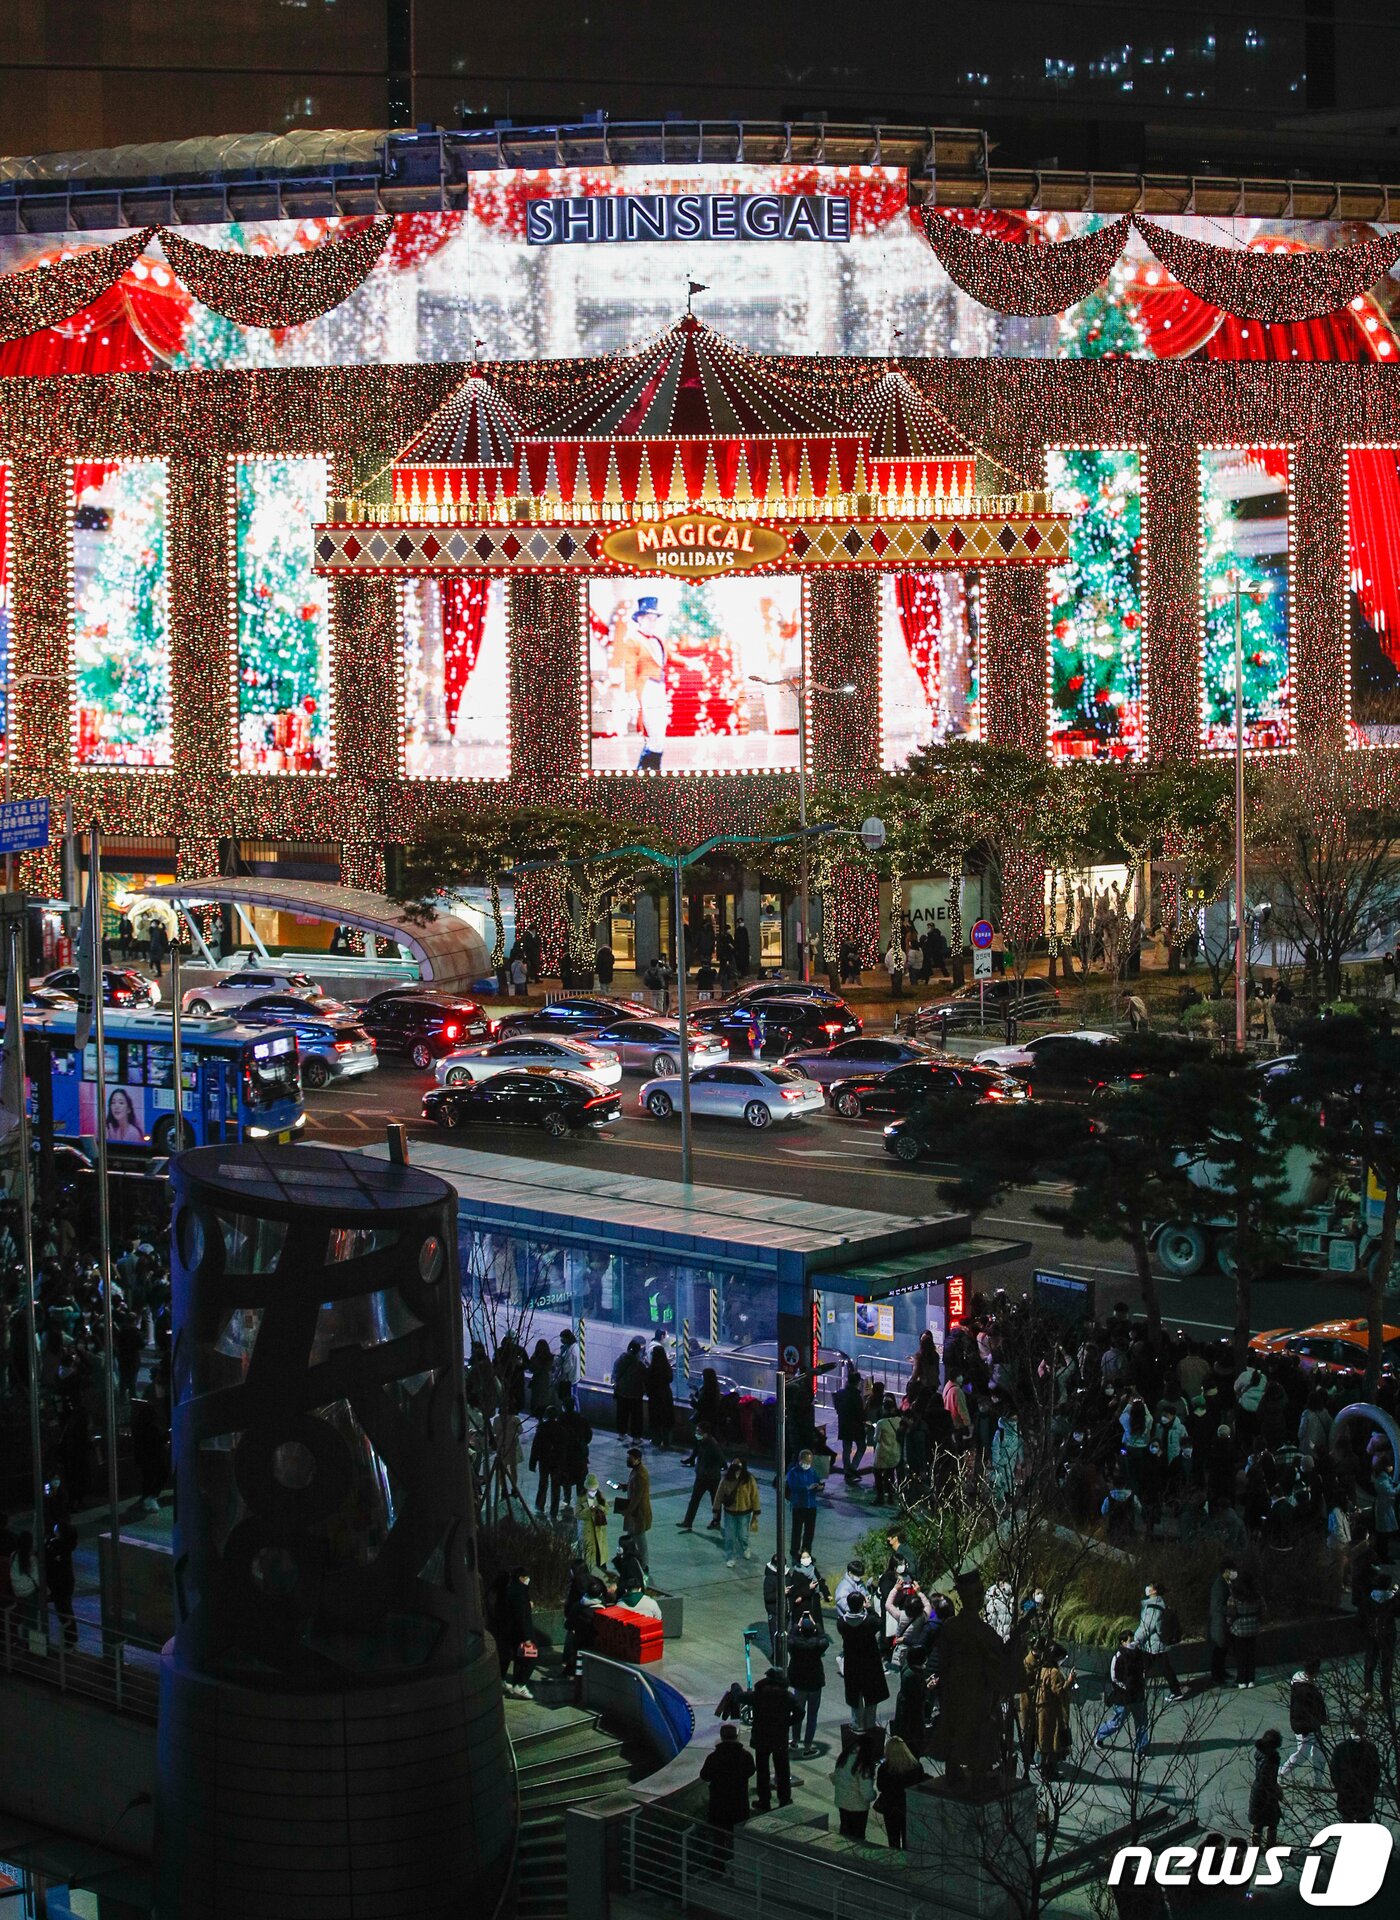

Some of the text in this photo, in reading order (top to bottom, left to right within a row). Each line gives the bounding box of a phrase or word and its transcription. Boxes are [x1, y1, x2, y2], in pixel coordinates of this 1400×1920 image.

[529, 195, 847, 240] SHINSEGAE
[636, 523, 755, 553] MAGICAL
[656, 552, 735, 567] HOLIDAYS
[0, 814, 46, 830] 잡통행료징수
[890, 906, 952, 922] HANE
